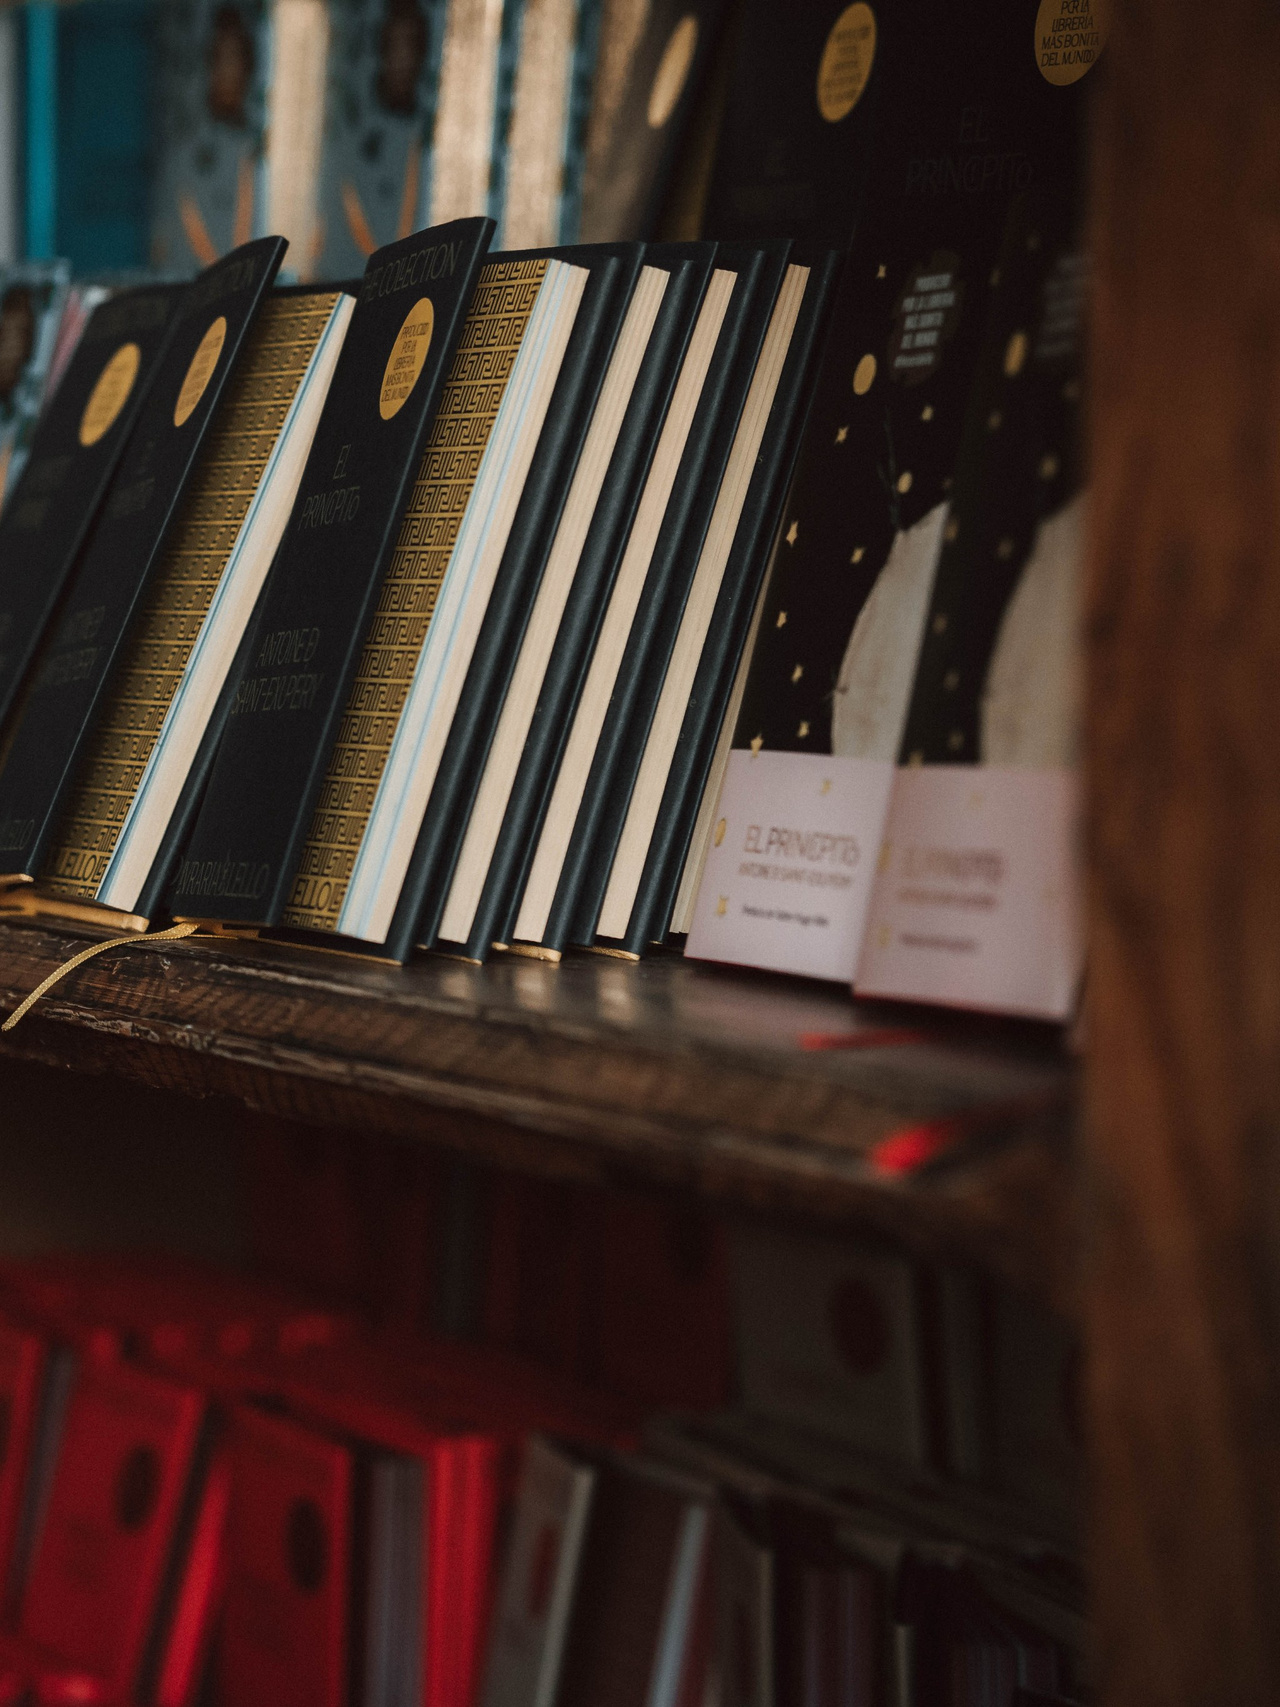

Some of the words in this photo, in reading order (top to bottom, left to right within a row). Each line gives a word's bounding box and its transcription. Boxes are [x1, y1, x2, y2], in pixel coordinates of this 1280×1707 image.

[1060, 0, 1079, 14] POR
[1064, 31, 1100, 48] BONITA
[1041, 51, 1060, 67] DEL
[1061, 49, 1095, 66] MUNDO
[332, 444, 352, 480] EL
